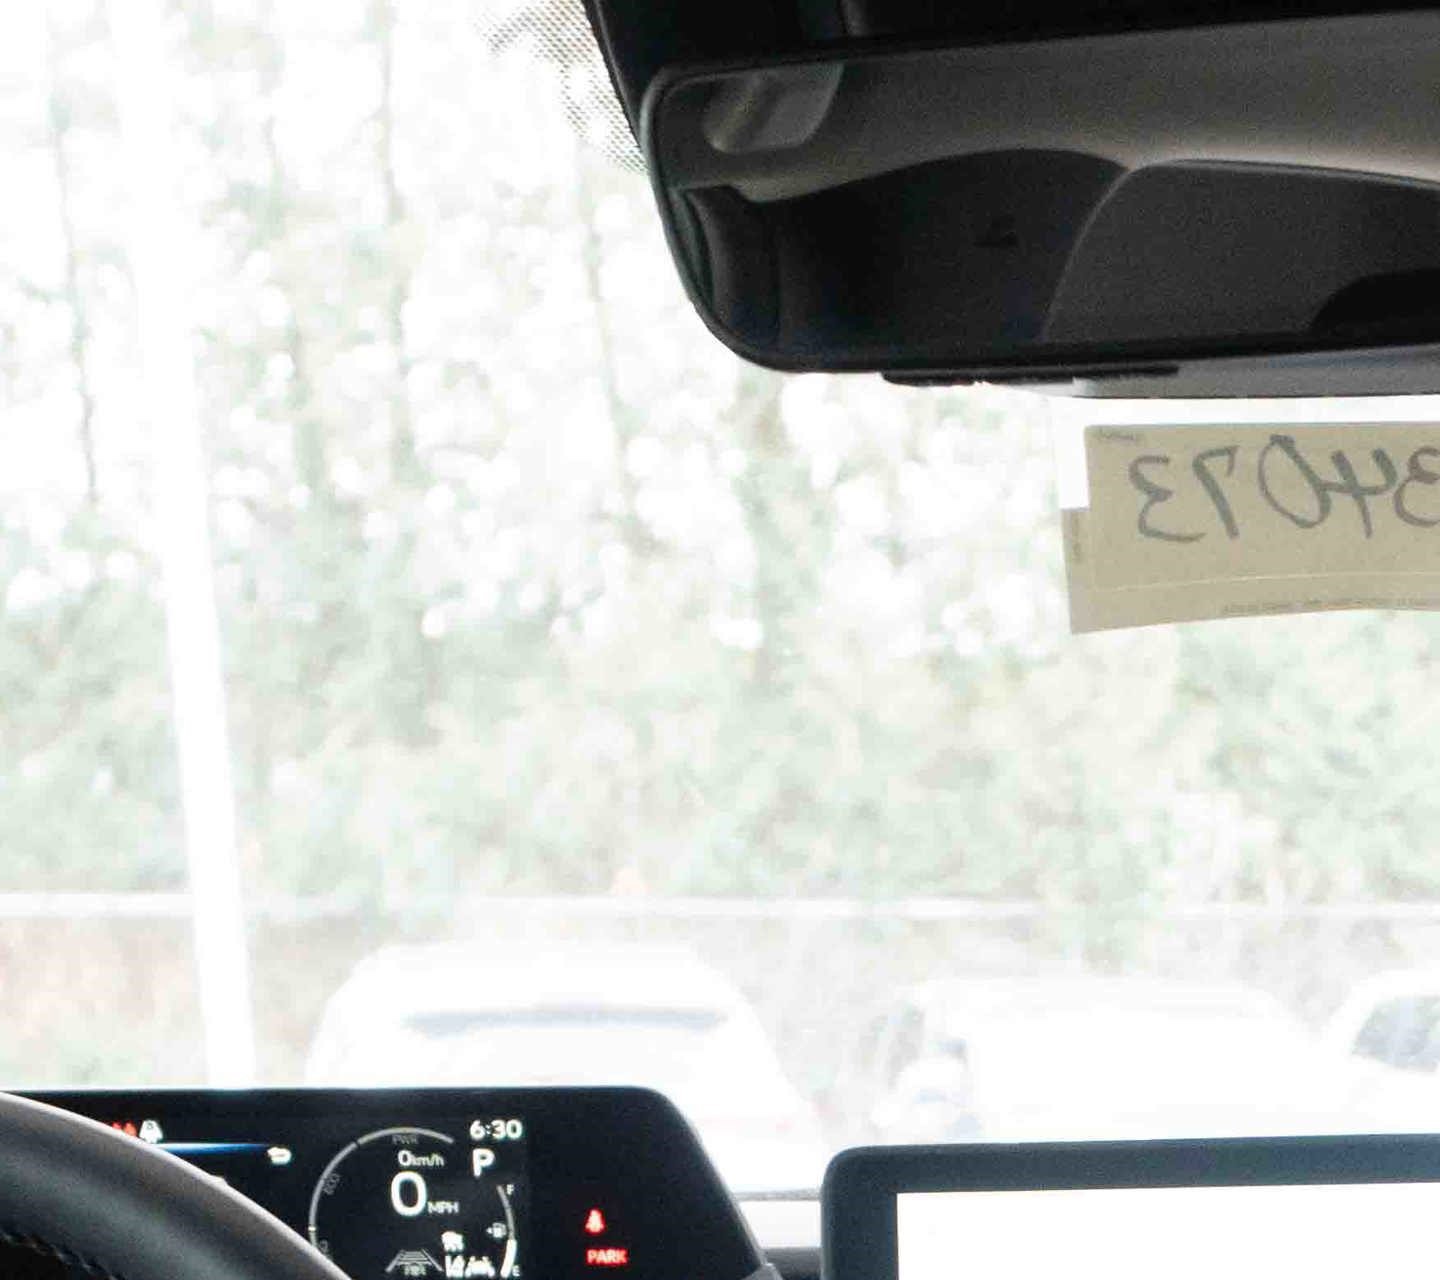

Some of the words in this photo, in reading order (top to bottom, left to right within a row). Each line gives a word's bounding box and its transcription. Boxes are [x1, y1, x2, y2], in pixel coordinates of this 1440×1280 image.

[469, 1119, 523, 1140] 6:30
[471, 1147, 496, 1178] P
[390, 1169, 427, 1217] 0
[427, 1201, 460, 1215] MPH
[585, 1247, 629, 1266] PARK
